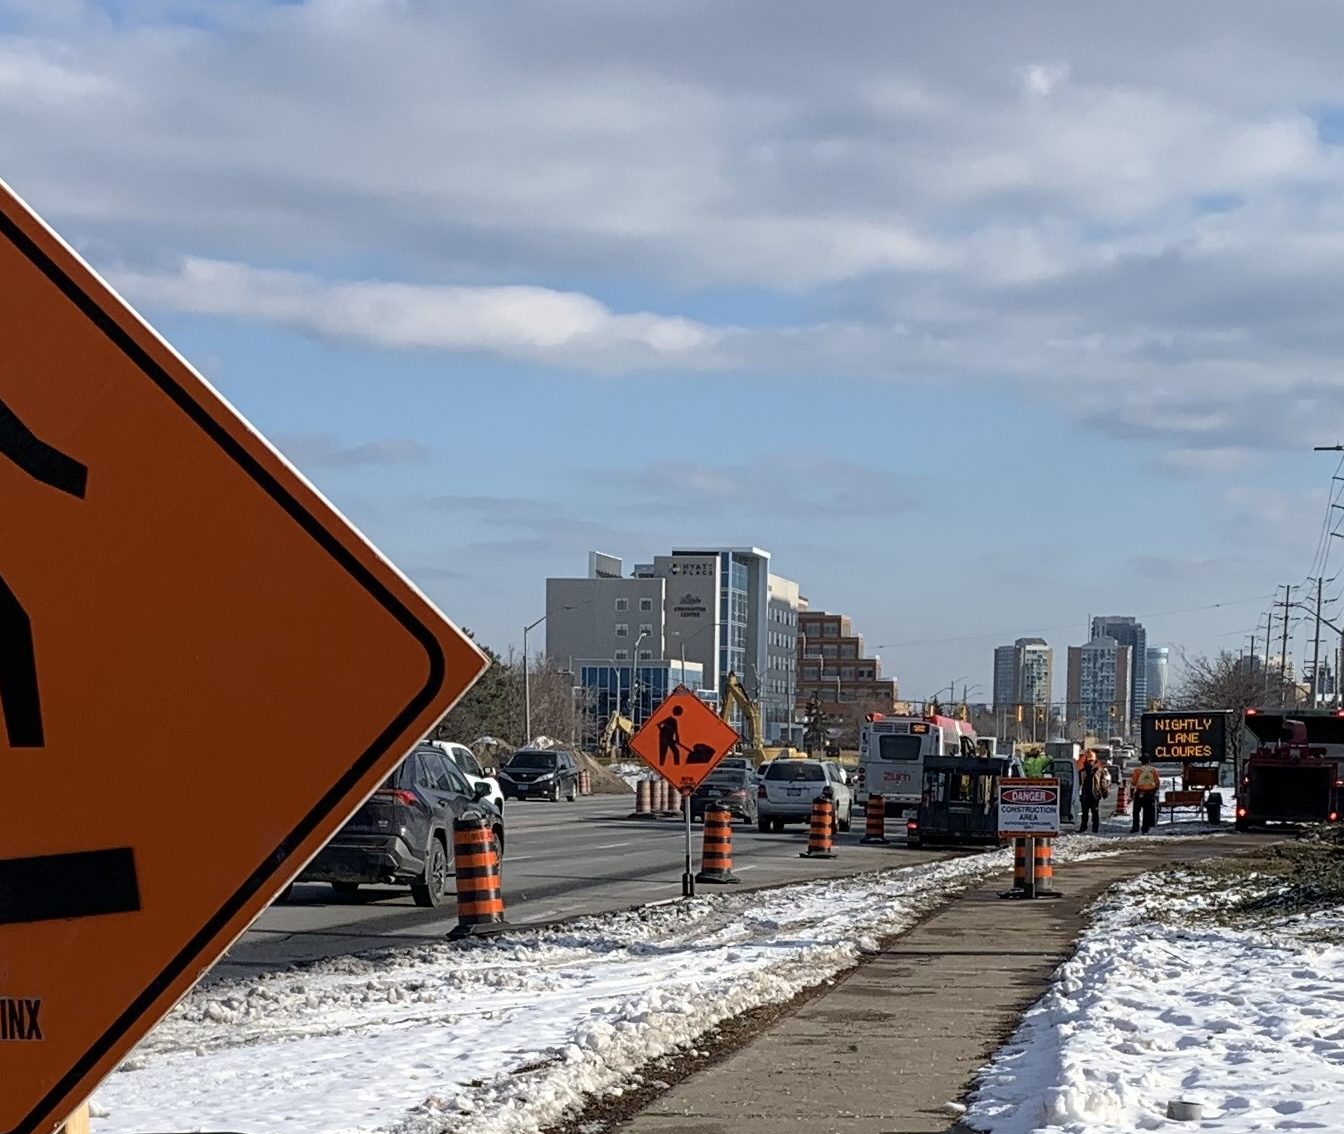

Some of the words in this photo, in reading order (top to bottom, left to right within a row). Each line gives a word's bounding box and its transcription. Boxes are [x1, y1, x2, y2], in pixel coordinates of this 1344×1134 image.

[1155, 718, 1213, 730] NIGHTLY
[1167, 733, 1200, 744] LANE
[1155, 745, 1213, 757] CLOURES
[1012, 791, 1046, 802] DANGER
